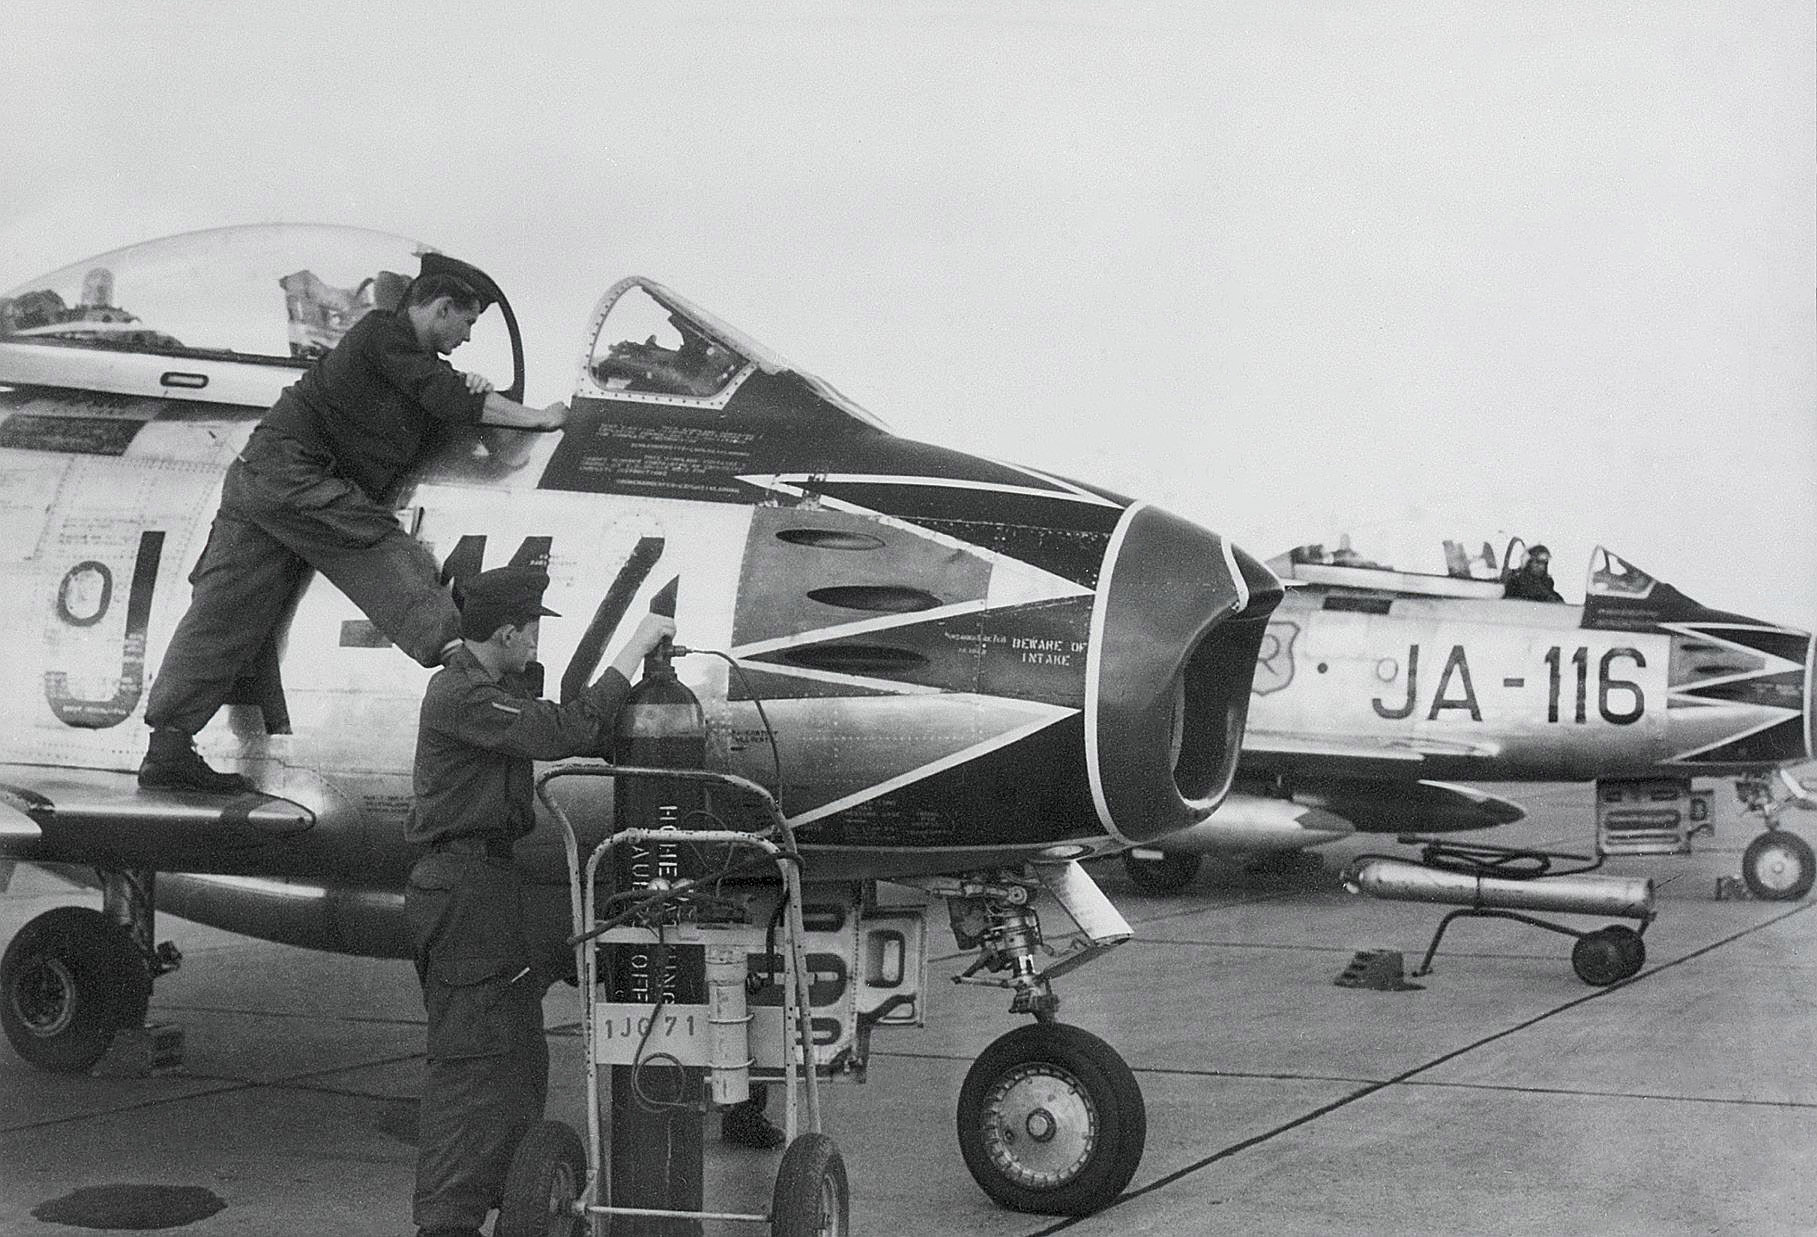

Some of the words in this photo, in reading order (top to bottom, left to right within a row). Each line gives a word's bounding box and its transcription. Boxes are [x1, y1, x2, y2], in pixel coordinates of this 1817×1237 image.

[1012, 638, 1063, 651] BEWARE
[1071, 642, 1087, 652] OF
[1022, 652, 1070, 666] INTAKE
